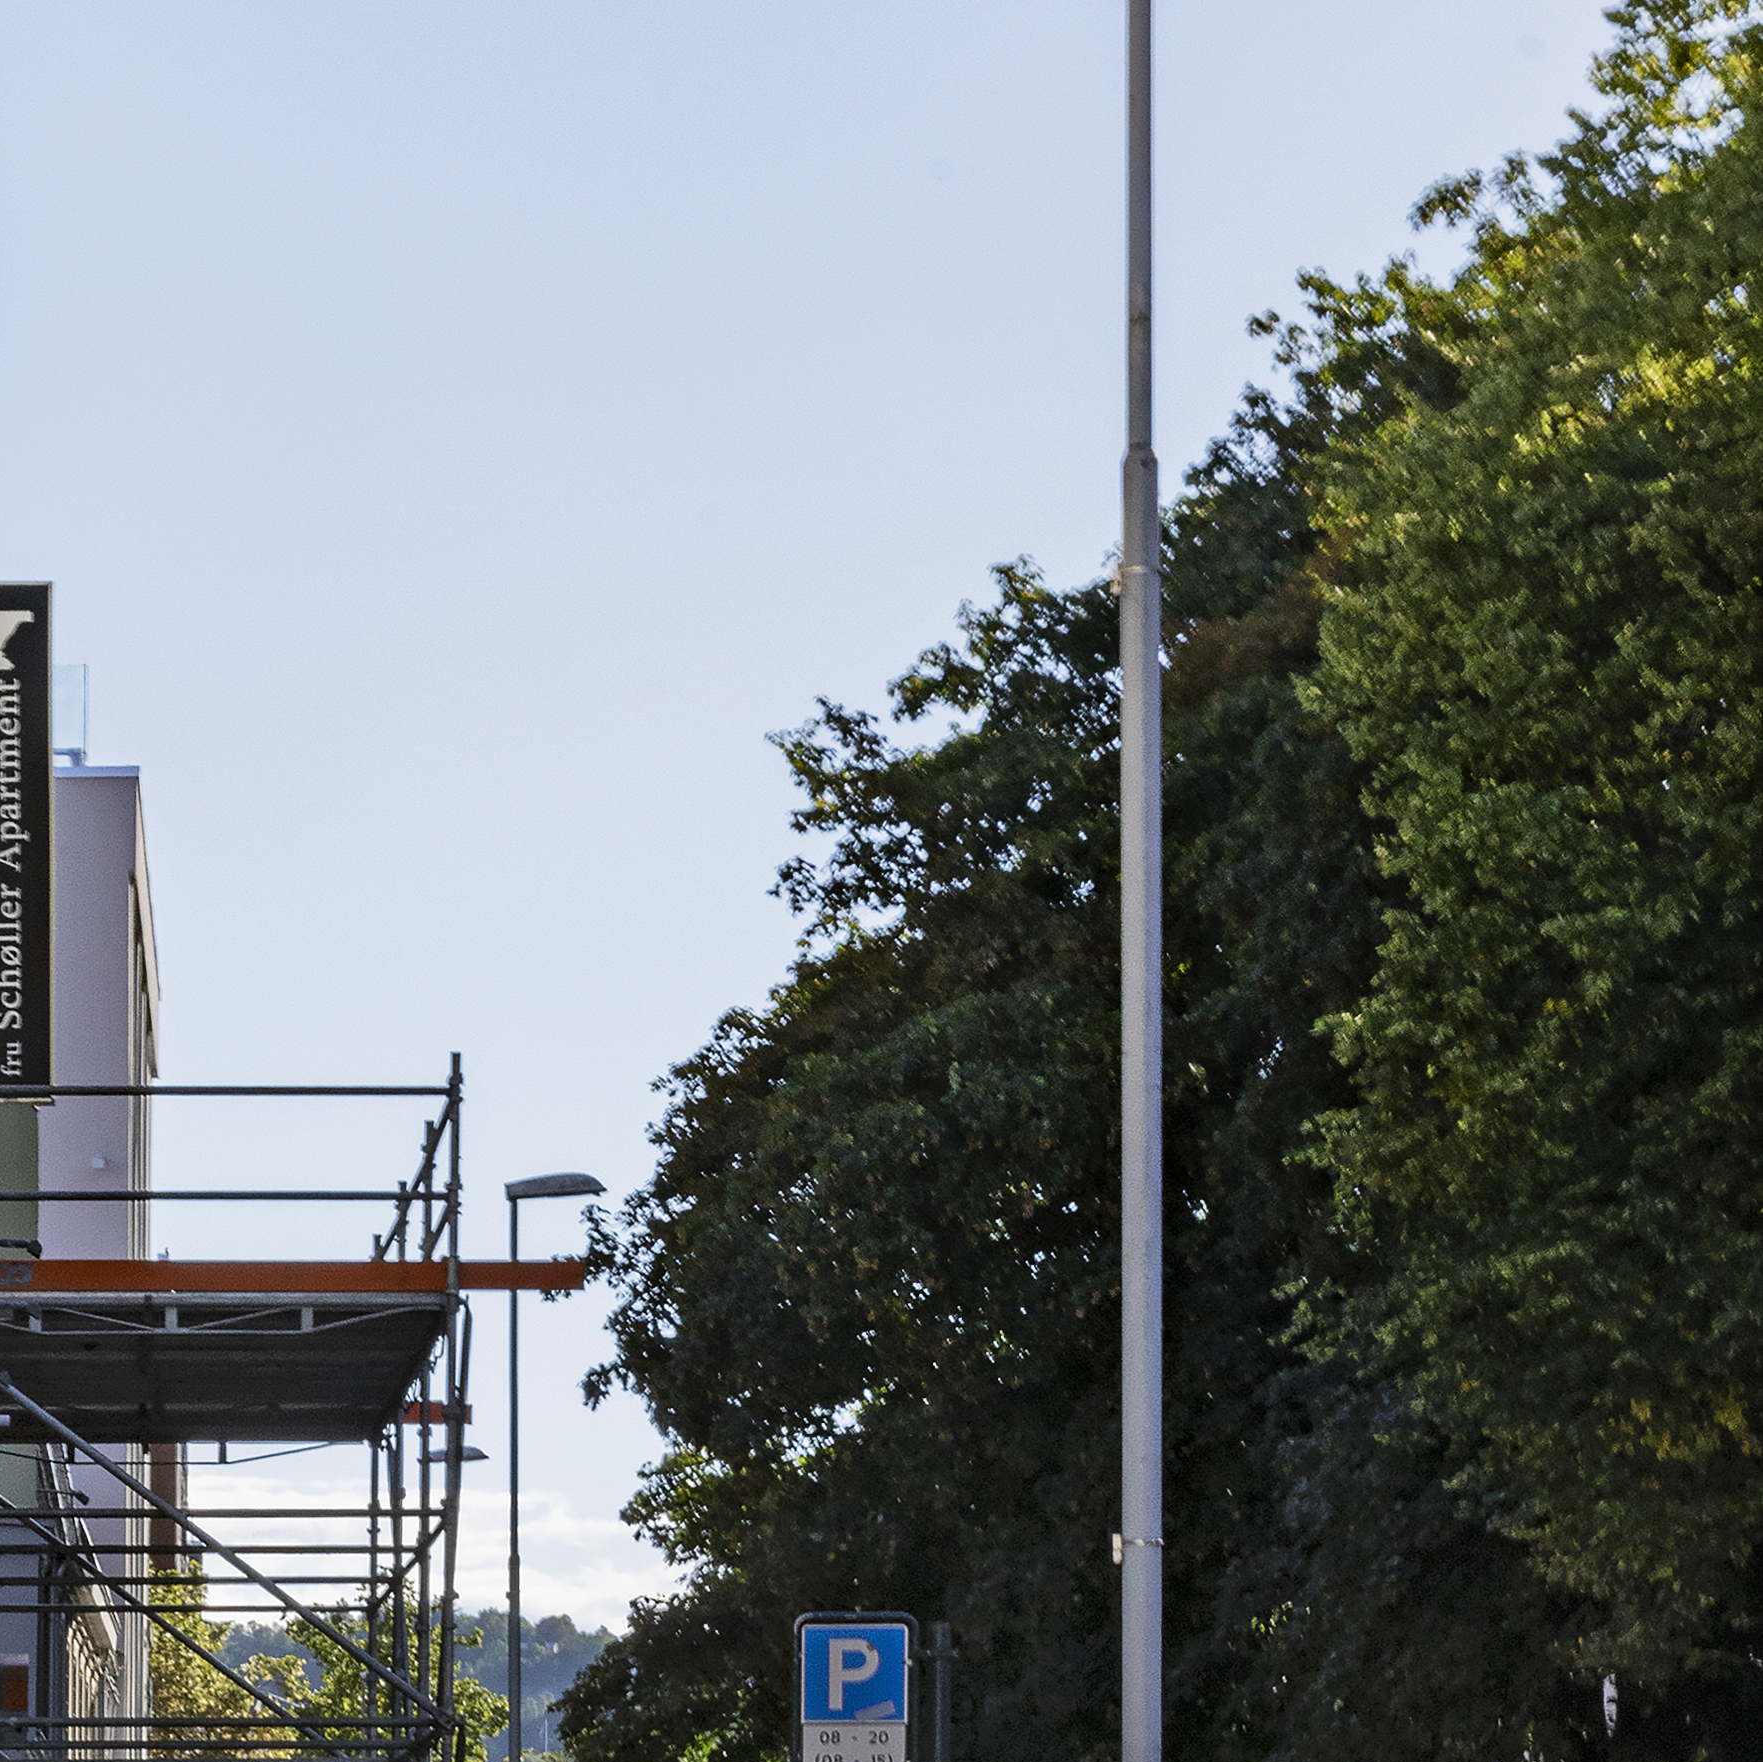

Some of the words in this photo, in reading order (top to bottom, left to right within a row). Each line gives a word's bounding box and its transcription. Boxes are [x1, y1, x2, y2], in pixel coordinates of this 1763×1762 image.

[0, 1040, 23, 1078] fru
[828, 1637, 880, 1712] P
[819, 1730, 841, 1745] 08
[868, 1730, 889, 1745] 20
